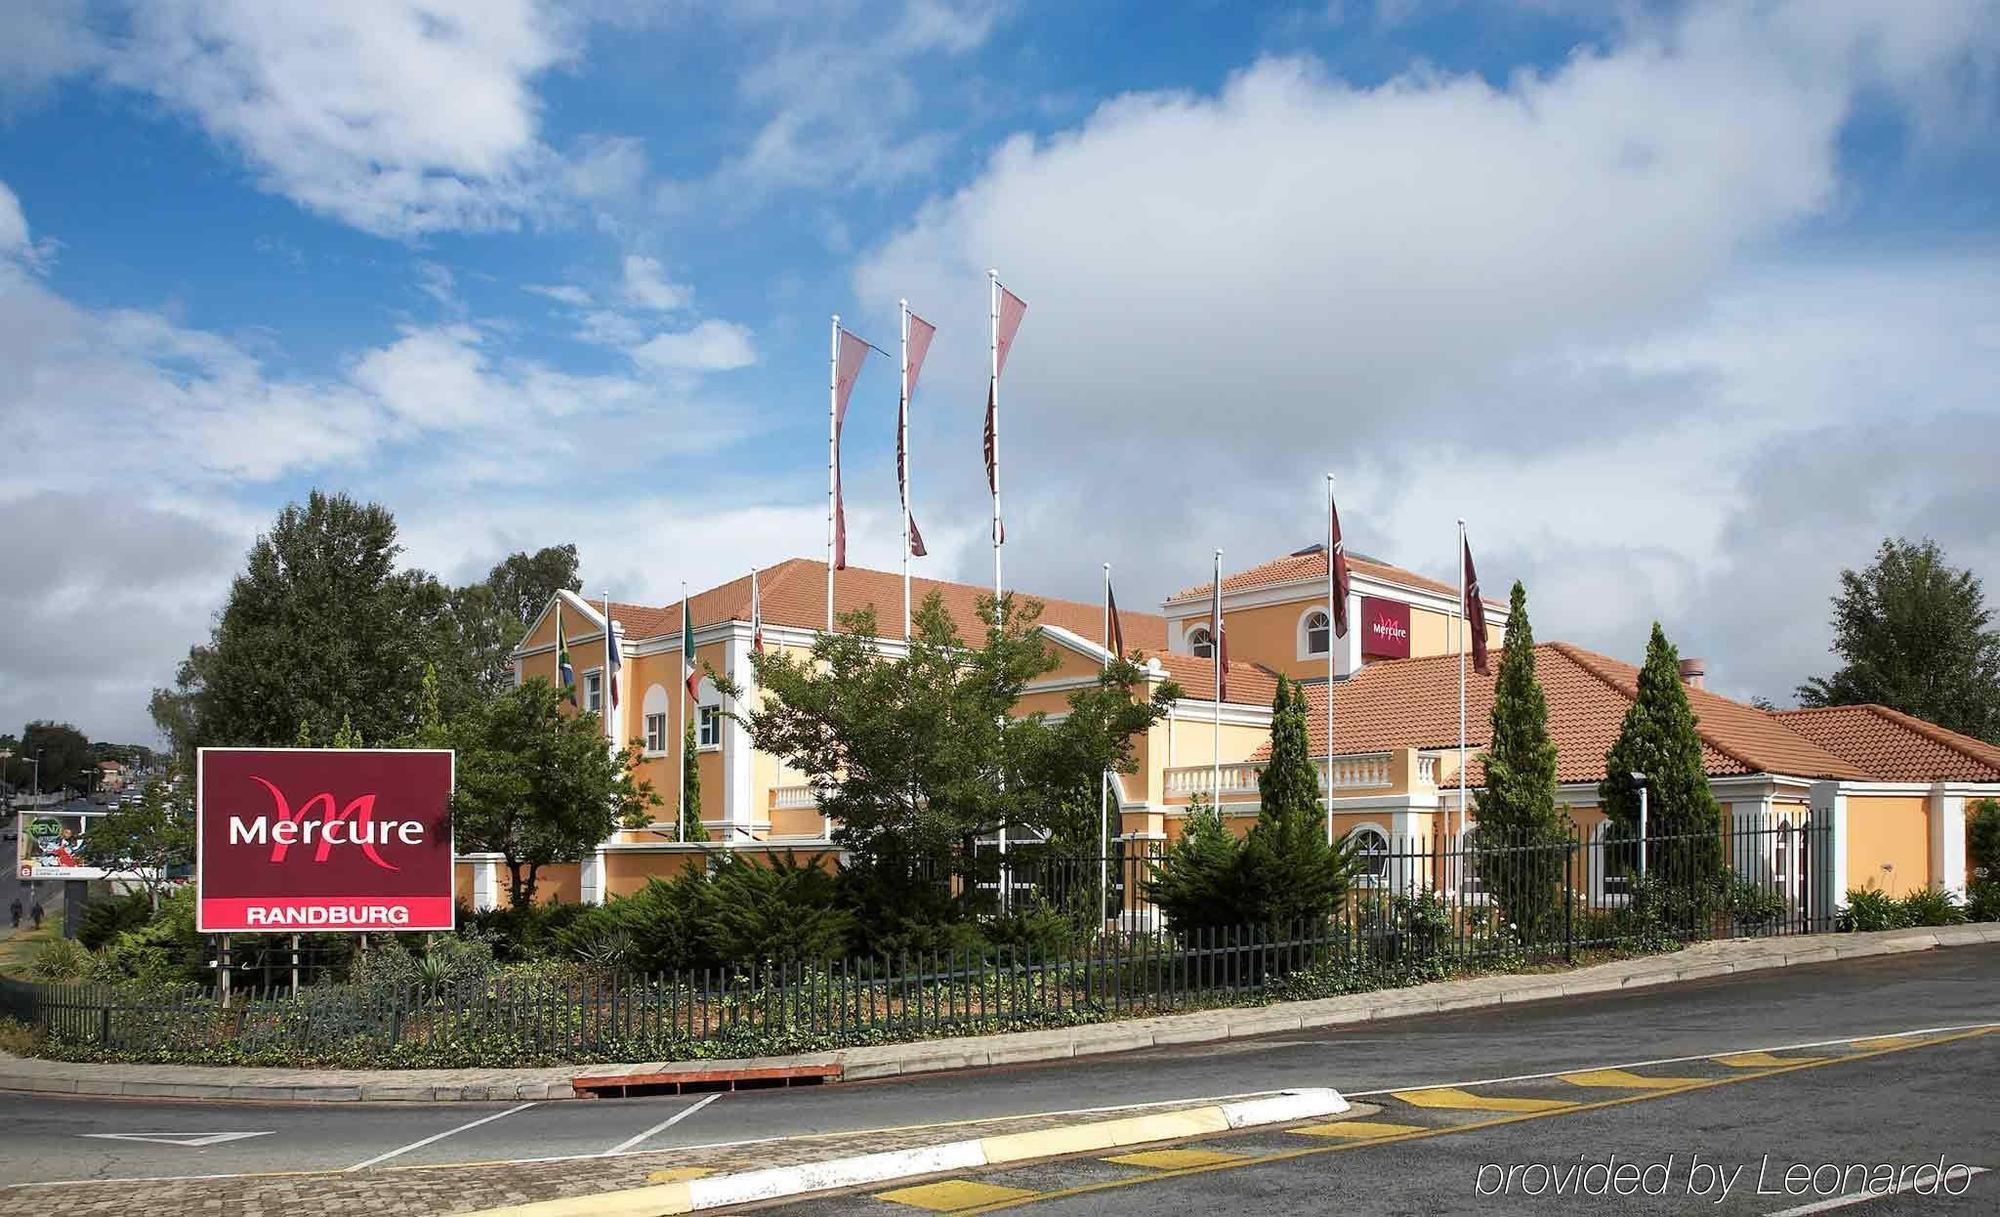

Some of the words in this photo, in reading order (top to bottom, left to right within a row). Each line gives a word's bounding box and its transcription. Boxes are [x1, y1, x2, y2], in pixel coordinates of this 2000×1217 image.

[1373, 623, 1407, 638] Mercure
[229, 816, 424, 845] Mercure
[246, 905, 410, 925] RANDBURG
